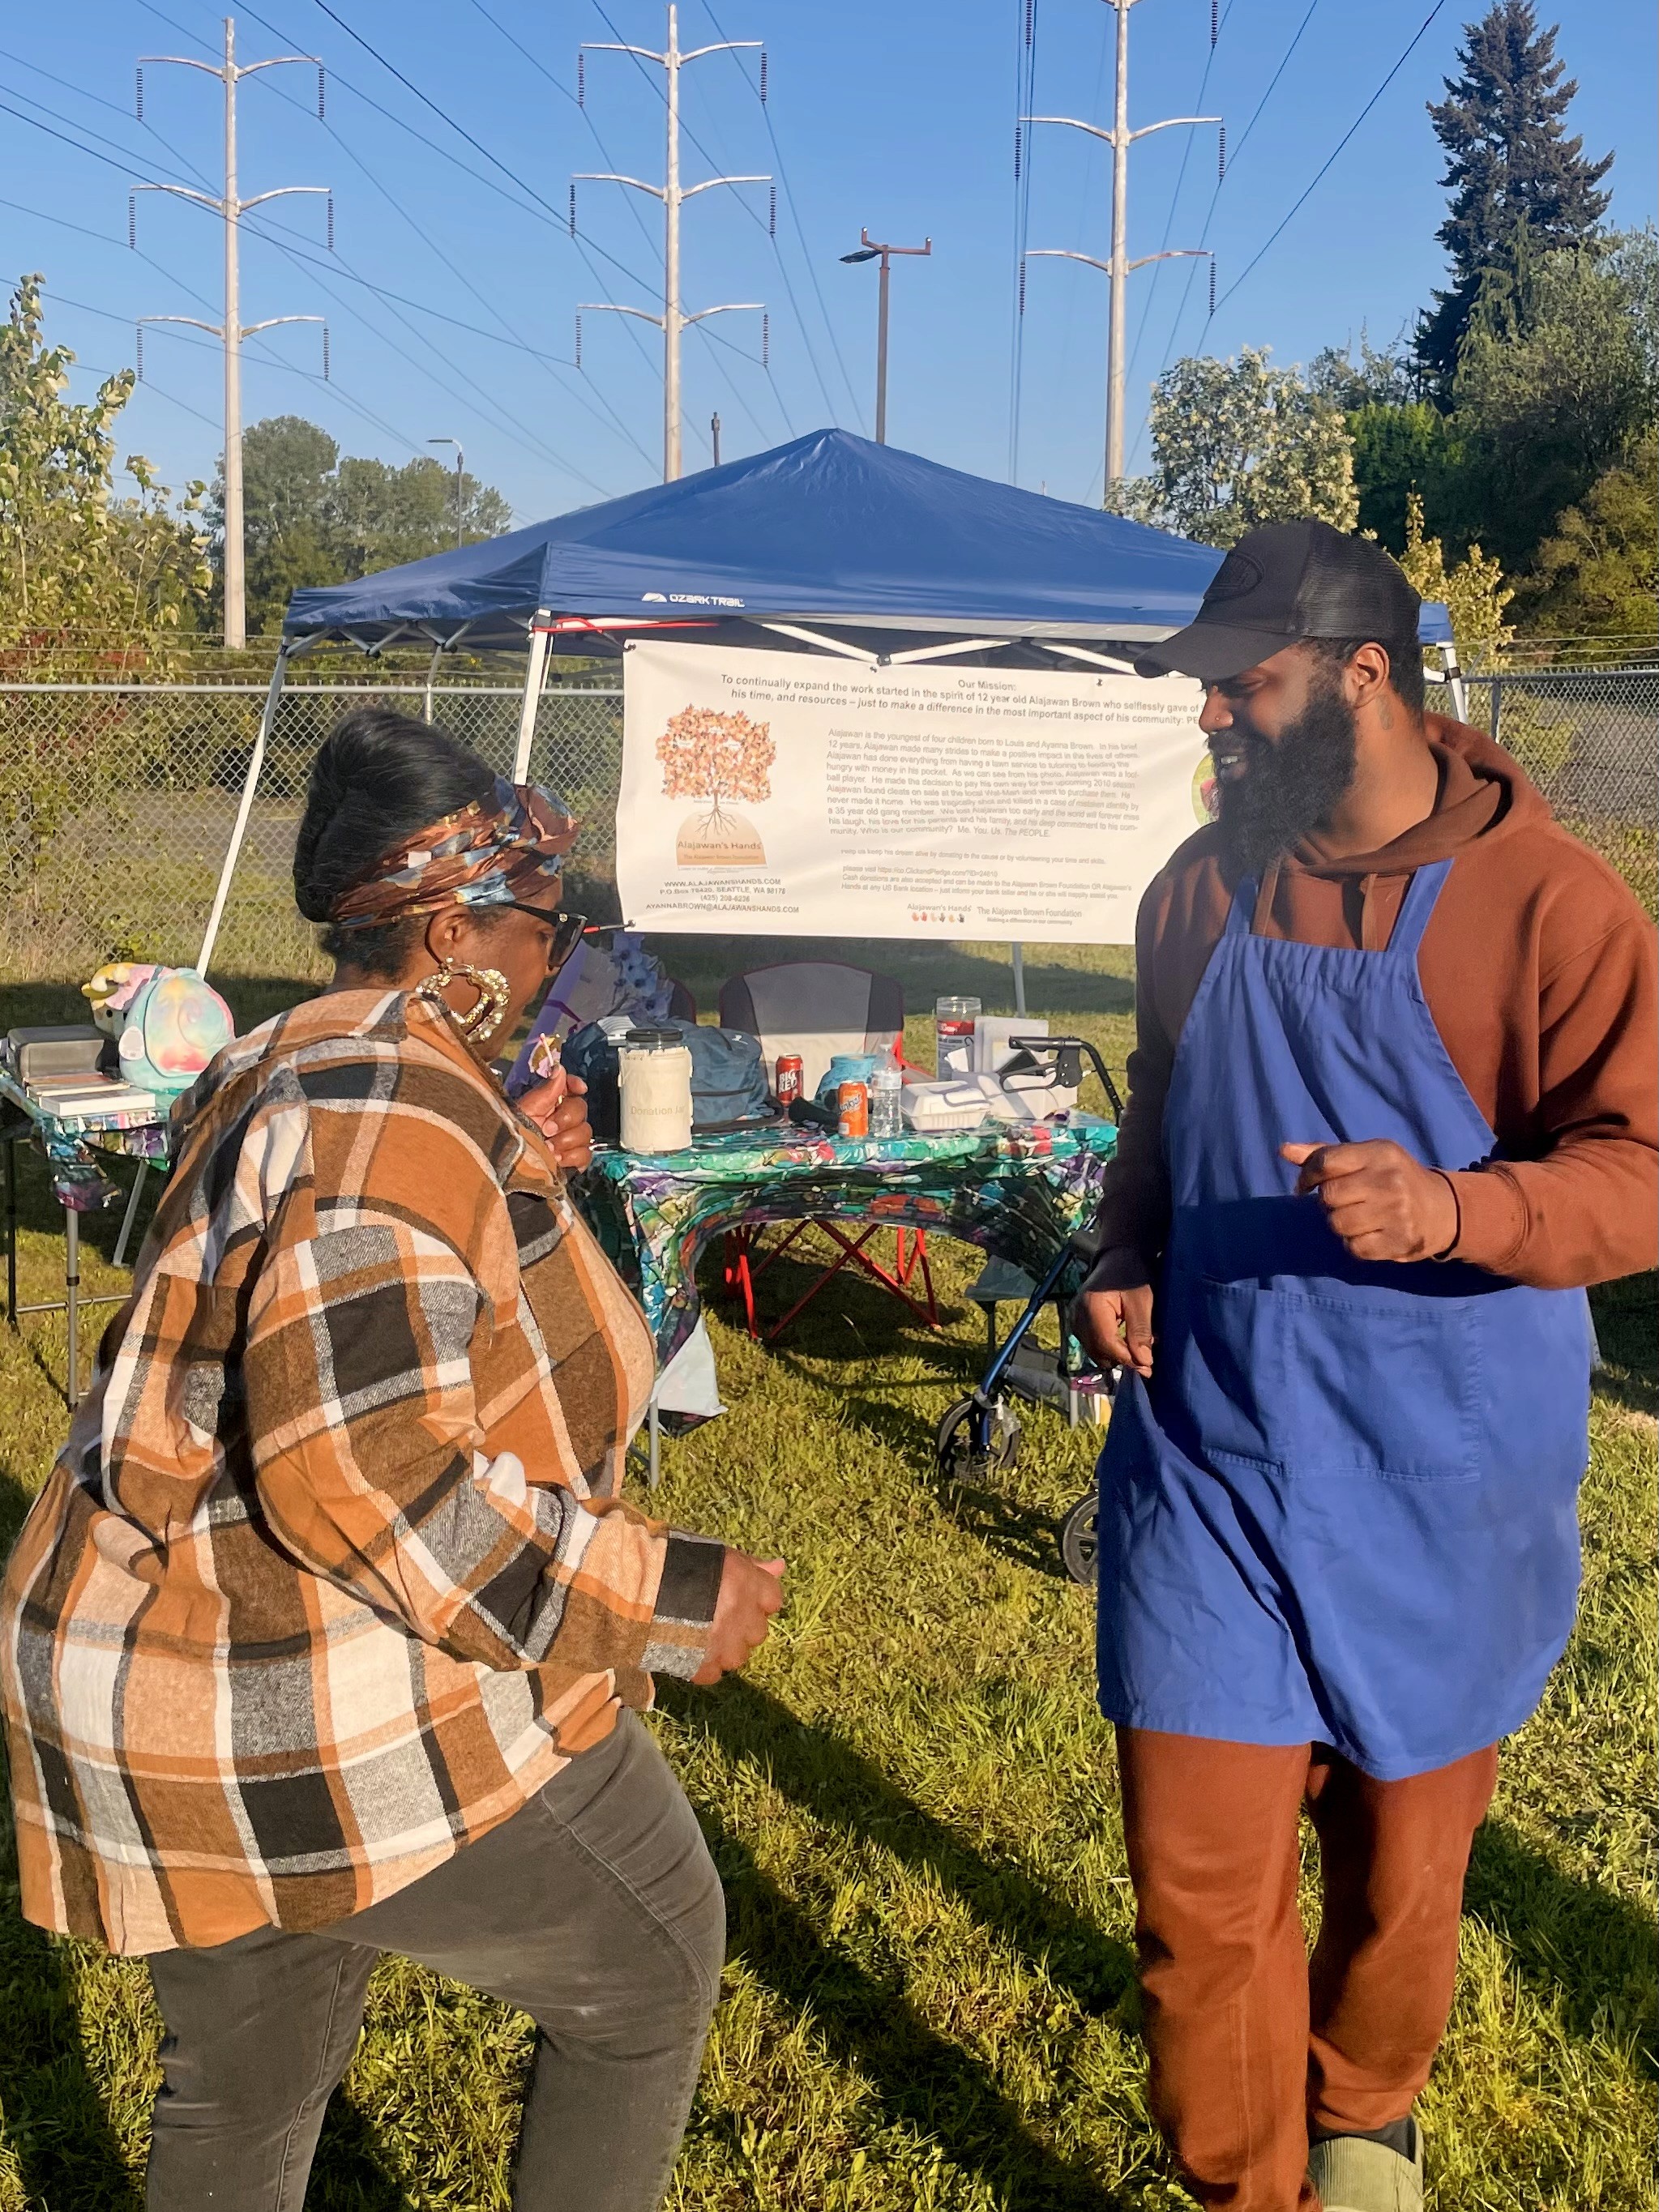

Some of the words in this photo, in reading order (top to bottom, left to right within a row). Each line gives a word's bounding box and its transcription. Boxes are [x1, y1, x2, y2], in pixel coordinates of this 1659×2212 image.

[711, 596, 746, 608] TRAIL
[958, 679, 974, 688] Our
[977, 680, 1015, 690] Mission:
[721, 673, 733, 684] To
[736, 677, 791, 689] continually
[793, 681, 830, 692] expand
[832, 682, 848, 692] the
[849, 685, 874, 694] work
[875, 686, 909, 696] started
[911, 687, 920, 697] in
[922, 689, 938, 698] the
[939, 690, 965, 701] spirit
[965, 691, 975, 700] of
[977, 692, 989, 701] 12
[990, 695, 1011, 705] year
[1011, 694, 1027, 703] old
[1028, 696, 1069, 707] Alajawan
[1071, 698, 1101, 707] Brown
[1102, 700, 1122, 709] who
[1122, 701, 1165, 712] selflessly
[1166, 704, 1187, 715] gave
[1189, 703, 1199, 712] of
[732, 688, 746, 698] his
[750, 690, 773, 701] time,
[776, 694, 795, 702] and
[798, 695, 846, 705] resources
[857, 698, 875, 709] just
[879, 699, 887, 708] to
[891, 702, 915, 710] make
[926, 702, 973, 713] difference
[975, 705, 983, 714] in
[987, 706, 1000, 715] the
[1003, 708, 1025, 716] most
[1028, 709, 1071, 720] important
[1073, 712, 1102, 722] aspect
[1105, 712, 1114, 721] of
[1116, 712, 1129, 722] his
[1131, 715, 1183, 725] community:
[1187, 715, 1199, 724] PE
[828, 728, 863, 737] Alajawan
[865, 730, 871, 738] is
[873, 731, 885, 740] the
[887, 733, 921, 742] youngest
[921, 733, 930, 742] of
[931, 734, 945, 743] four
[947, 736, 976, 744] children
[977, 737, 994, 745] born
[995, 738, 1003, 746] to
[1004, 738, 1024, 747] Louis
[1026, 740, 1040, 748] and
[828, 739, 837, 748] 12
[863, 741, 898, 751] Alajawan
[900, 745, 921, 753] made
[922, 746, 943, 755] many
[944, 747, 969, 755] strides
[970, 747, 978, 756] to
[827, 750, 861, 760] Alajawan
[863, 753, 877, 761] has
[879, 754, 898, 762] done
[900, 756, 939, 766] everything
[940, 757, 956, 765] from
[958, 758, 983, 768] having
[826, 762, 852, 772] hungry
[854, 763, 870, 771] with
[871, 766, 897, 774] money
[899, 765, 905, 774] in
[908, 766, 918, 775] his
[951, 768, 961, 776] As
[1007, 770, 1024, 778] from
[1026, 770, 1037, 778] his
[826, 773, 840, 781] ball
[871, 775, 883, 784] He
[908, 777, 920, 785] the
[921, 778, 953, 786] decision
[964, 780, 977, 788] pay
[1028, 779, 1038, 788] for
[1093, 779, 1110, 787] 2010
[827, 784, 862, 793] Alajawan
[863, 785, 885, 794] found
[874, 796, 879, 805] it
[909, 797, 921, 805] He
[1050, 799, 1067, 807] case
[1067, 798, 1075, 809] of
[1131, 802, 1138, 811] by
[835, 806, 844, 814] 35
[847, 808, 863, 816] year
[866, 807, 878, 815] old
[880, 809, 900, 817] gang
[828, 816, 840, 824] his
[868, 818, 880, 826] his
[959, 814, 974, 822] and
[976, 815, 987, 823] his
[905, 824, 951, 834] community?
[1005, 827, 1016, 835] The
[678, 841, 729, 851] Alajawan's
[664, 878, 780, 886] WWW.ALAJAWANSHANDS.COM
[842, 873, 858, 881] Cash
[882, 883, 891, 891] US
[700, 894, 718, 902] (425)
[977, 906, 990, 915] The
[991, 907, 1021, 915] Alajawan
[1023, 907, 1044, 916] Brown
[1045, 907, 1081, 917] Foundation
[779, 1068, 797, 1083] BIG
[779, 1078, 797, 1094] RED
[631, 1106, 673, 1116] Donation
